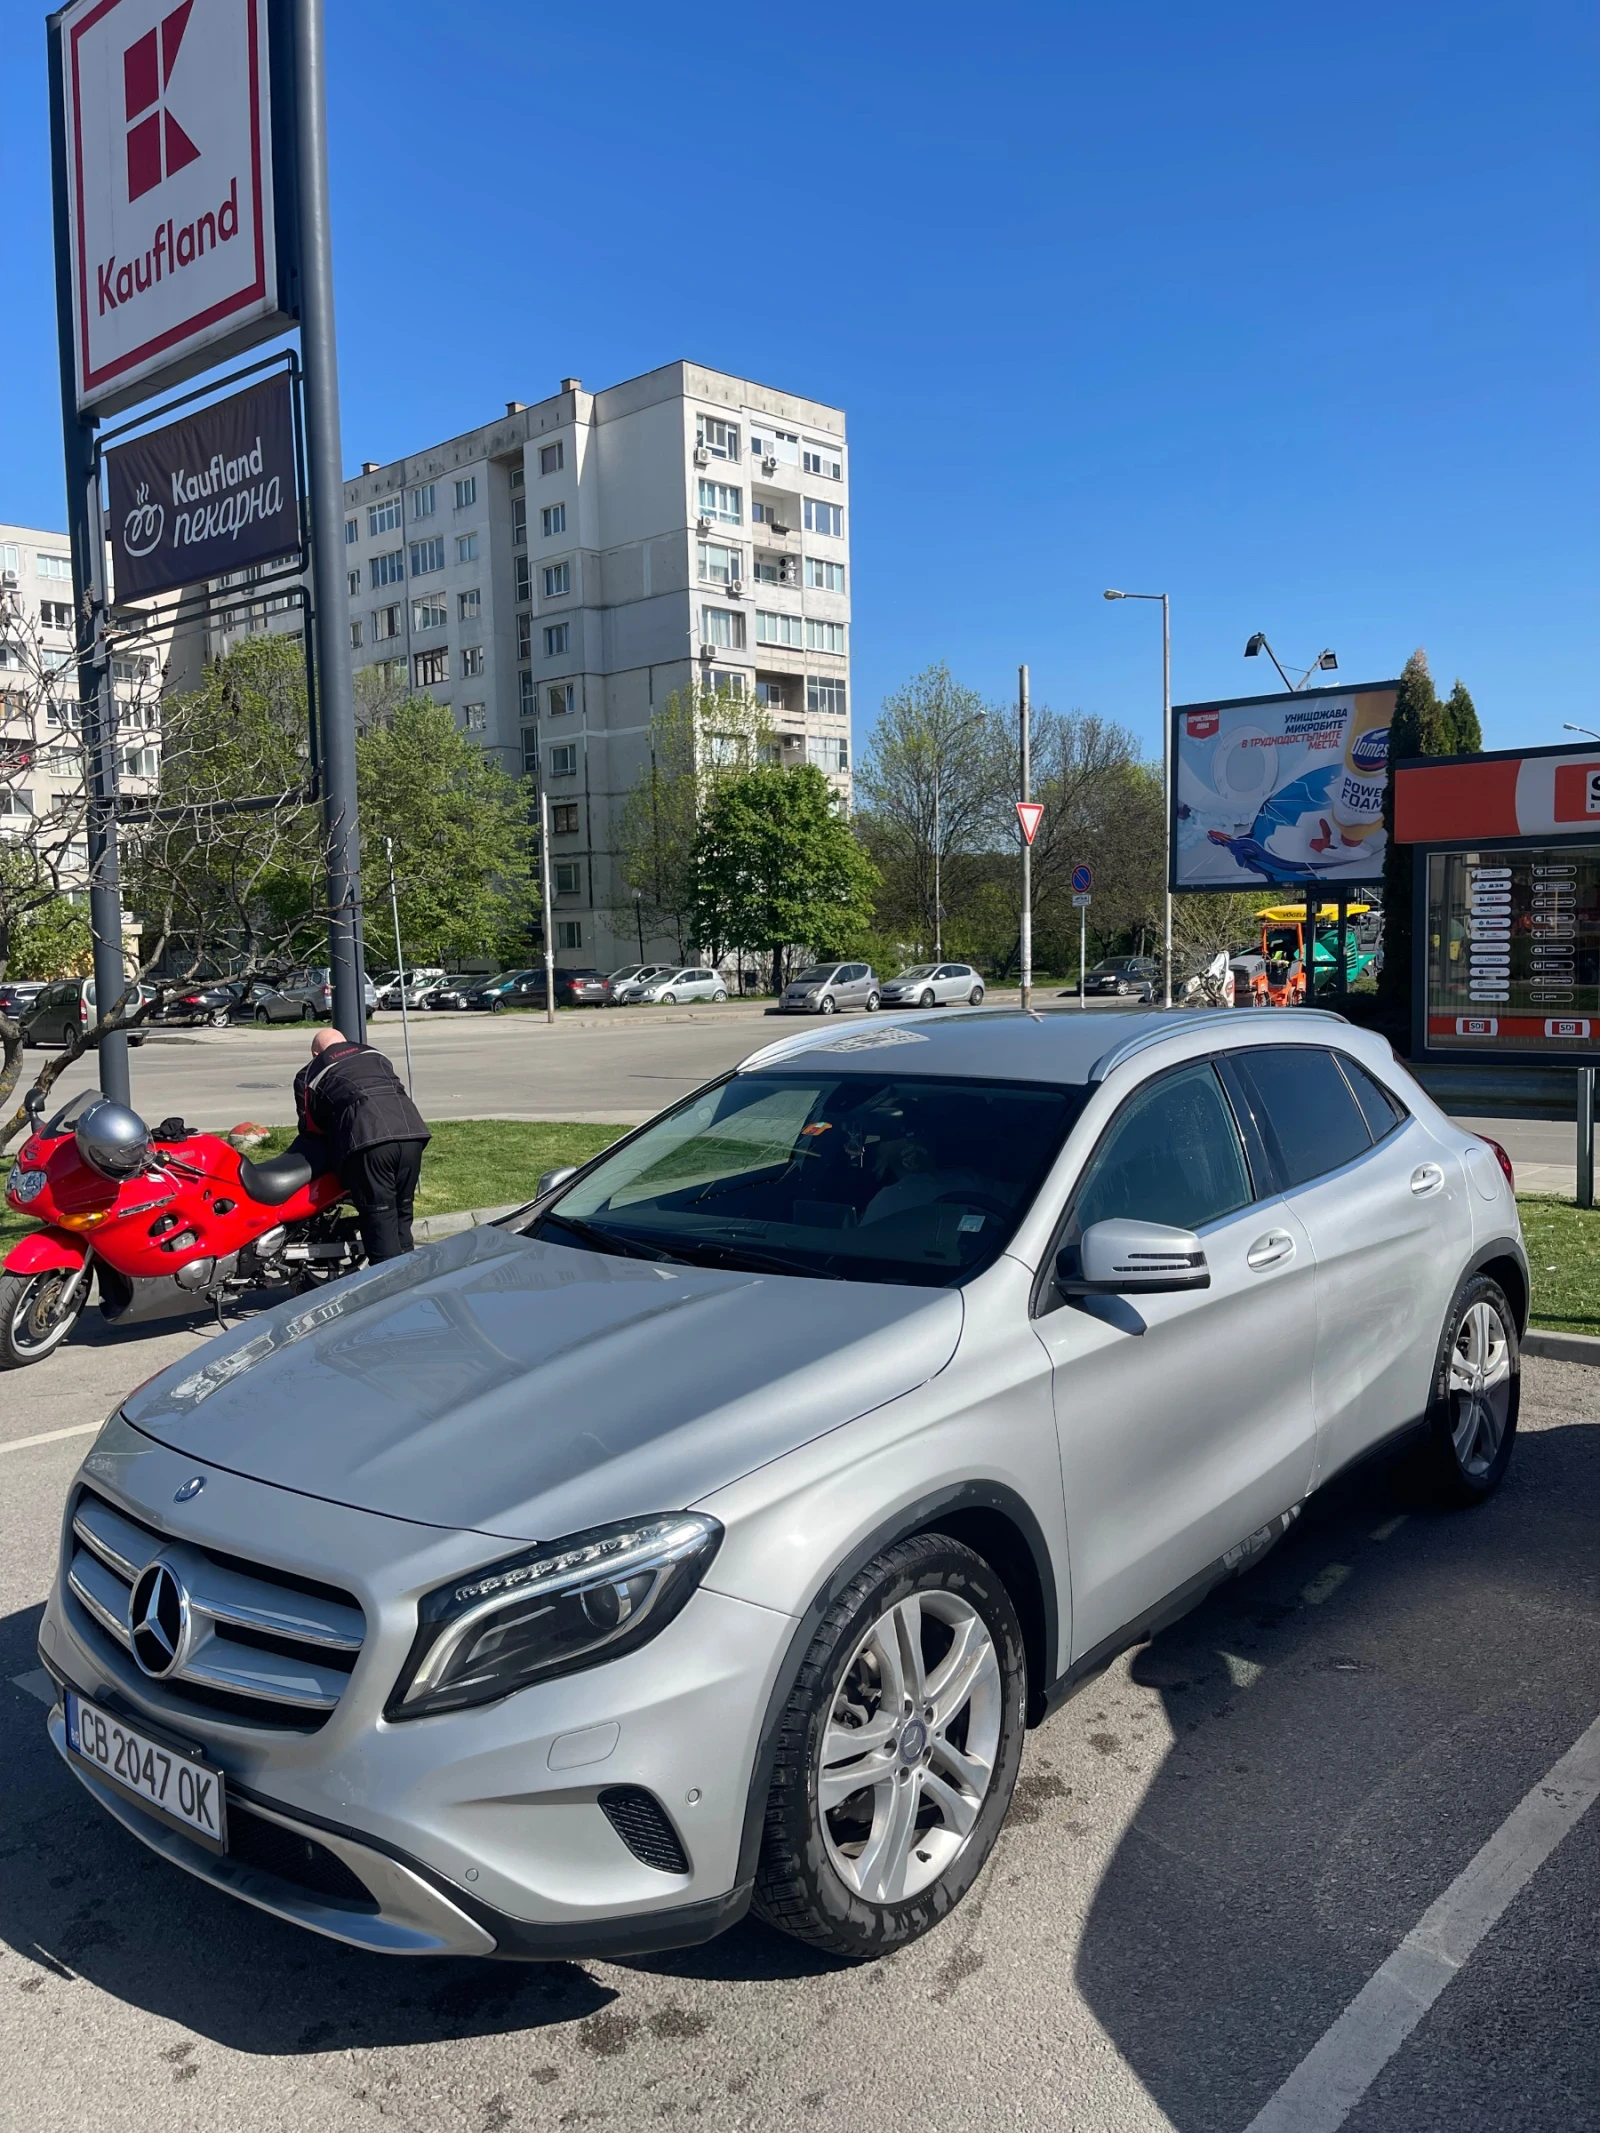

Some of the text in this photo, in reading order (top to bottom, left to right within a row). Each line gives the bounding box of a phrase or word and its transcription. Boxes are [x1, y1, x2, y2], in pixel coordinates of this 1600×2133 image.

[98, 176, 239, 317] Kaufland
[171, 436, 263, 507] Kaufland
[173, 475, 284, 548] пекарна
[1284, 708, 1348, 724] УНИЩОЖАВА
[1241, 730, 1343, 749] В ТРУДНОДОСТЪПНИТЕ
[1351, 735, 1389, 758] Domes
[1344, 777, 1383, 798] POWE
[1470, 1022, 1484, 1030] SDI
[81, 1708, 215, 1830] CB 2047 OK
